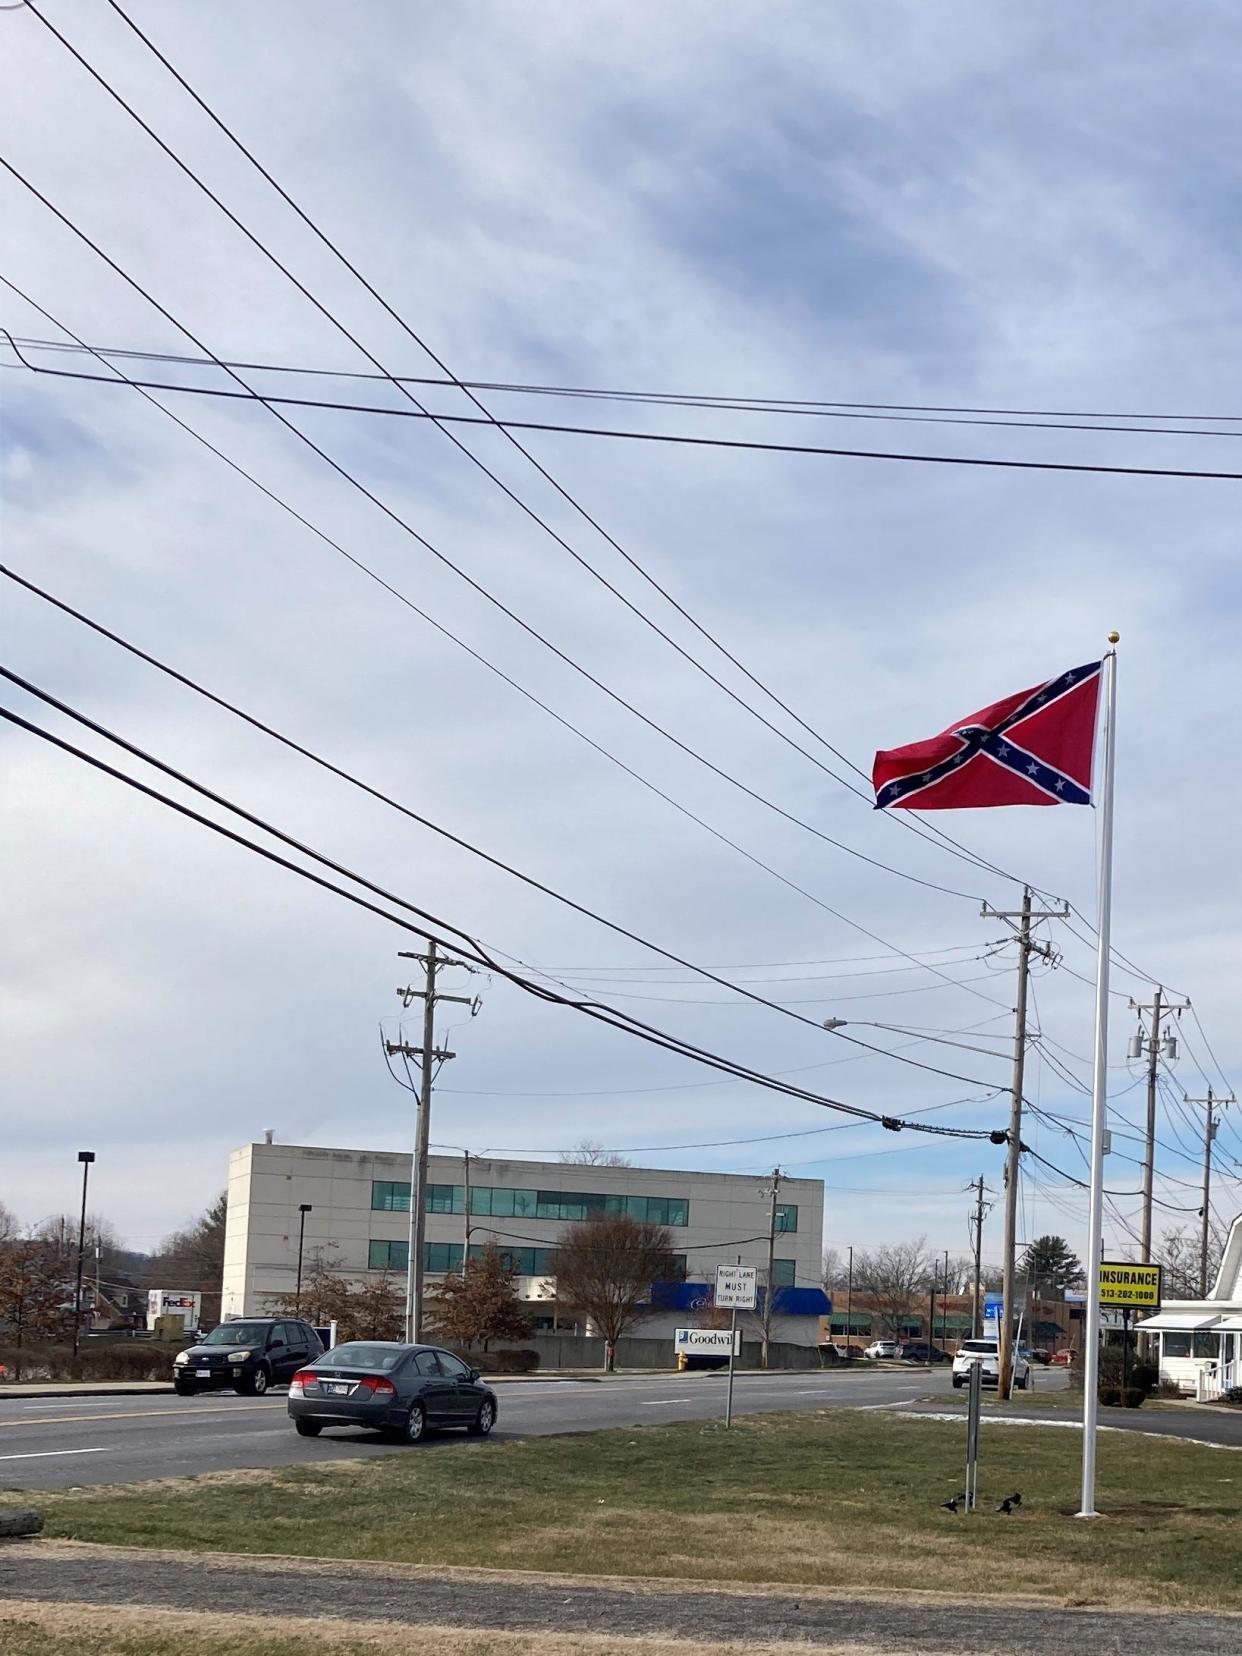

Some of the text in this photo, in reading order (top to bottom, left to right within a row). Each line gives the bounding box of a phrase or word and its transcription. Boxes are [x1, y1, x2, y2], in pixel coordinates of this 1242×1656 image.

[719, 1270, 736, 1278] RIGHT
[1099, 1270, 1157, 1286] INSURANCE
[725, 1281, 747, 1292] MUST
[163, 1296, 195, 1308] FedEx
[735, 1295, 753, 1303] RIGHT
[689, 1331, 733, 1345] Goodwil
